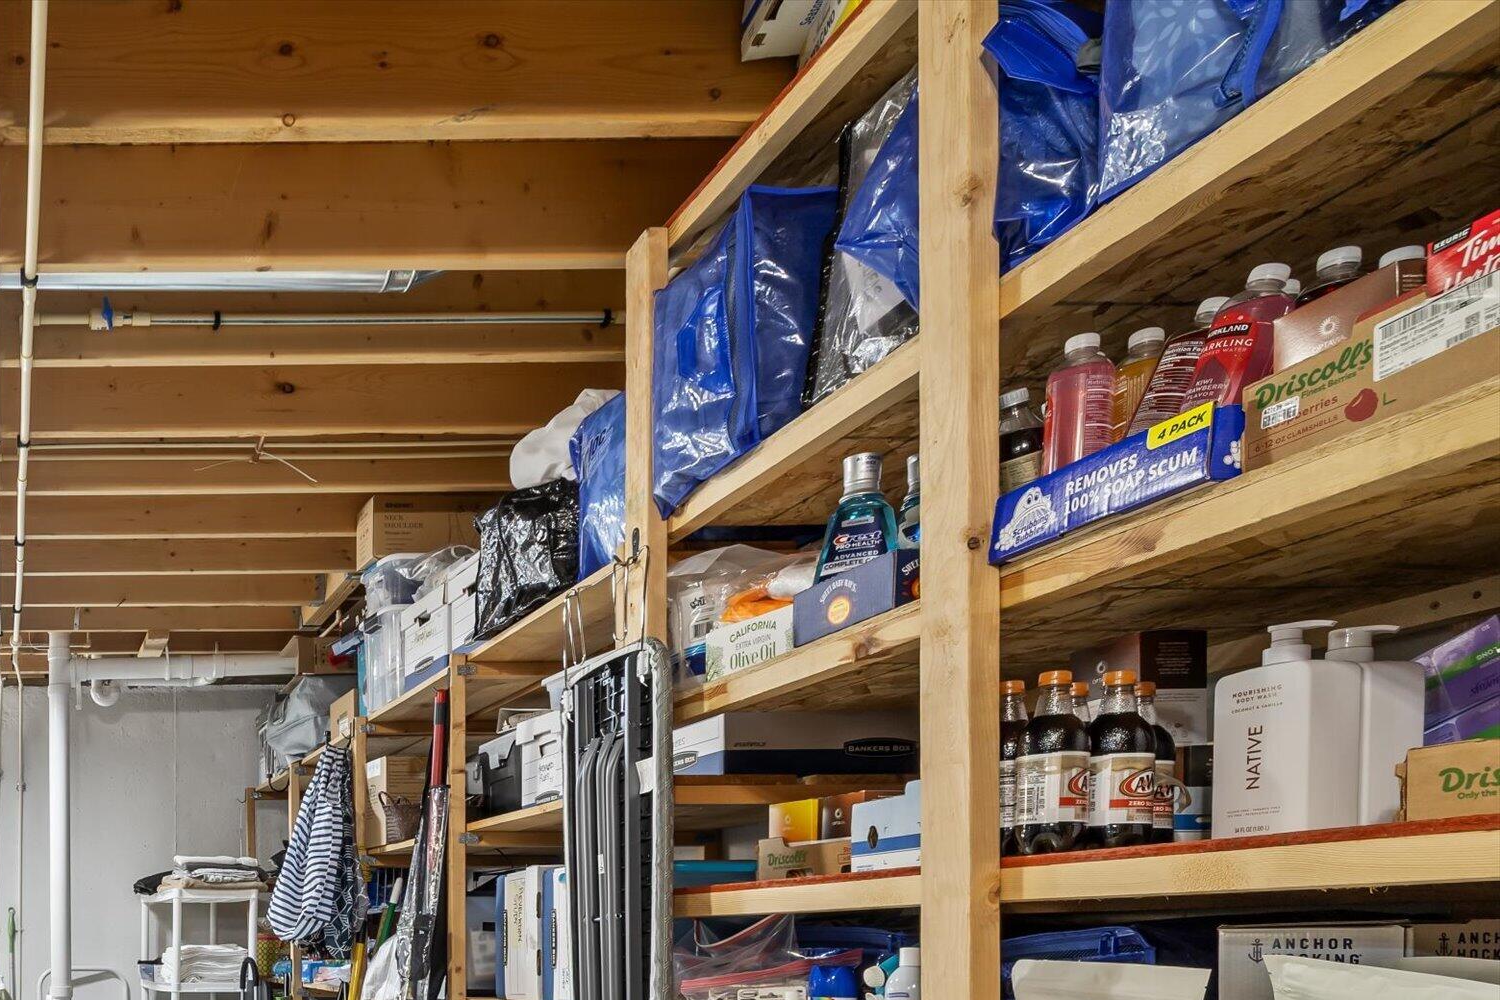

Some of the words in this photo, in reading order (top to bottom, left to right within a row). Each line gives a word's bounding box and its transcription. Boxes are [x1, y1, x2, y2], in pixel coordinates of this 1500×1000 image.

[1203, 339, 1254, 353] ARKLING
[1255, 339, 1374, 411] Driscoll's
[1327, 371, 1357, 390] Berries
[1186, 383, 1229, 395] RAWBERRY
[1157, 428, 1167, 441] 4
[1168, 411, 1207, 435] PACK
[1065, 454, 1139, 497] REMOVES
[1065, 488, 1101, 514] 100%
[1103, 468, 1146, 499] SOAP
[1149, 447, 1199, 476] SCUM
[1012, 514, 1050, 538] Scrubbing
[1015, 525, 1046, 544] Bubbles
[824, 559, 864, 571] COMPLETE
[834, 550, 879, 561] ADVANCED
[729, 620, 777, 643] CALIFORNIA
[730, 650, 759, 671] Olive
[760, 642, 777, 660] Oil
[1232, 684, 1283, 699] NOURISHING
[1246, 725, 1263, 791] NATIVE
[1272, 937, 1354, 950] ANCHOR
